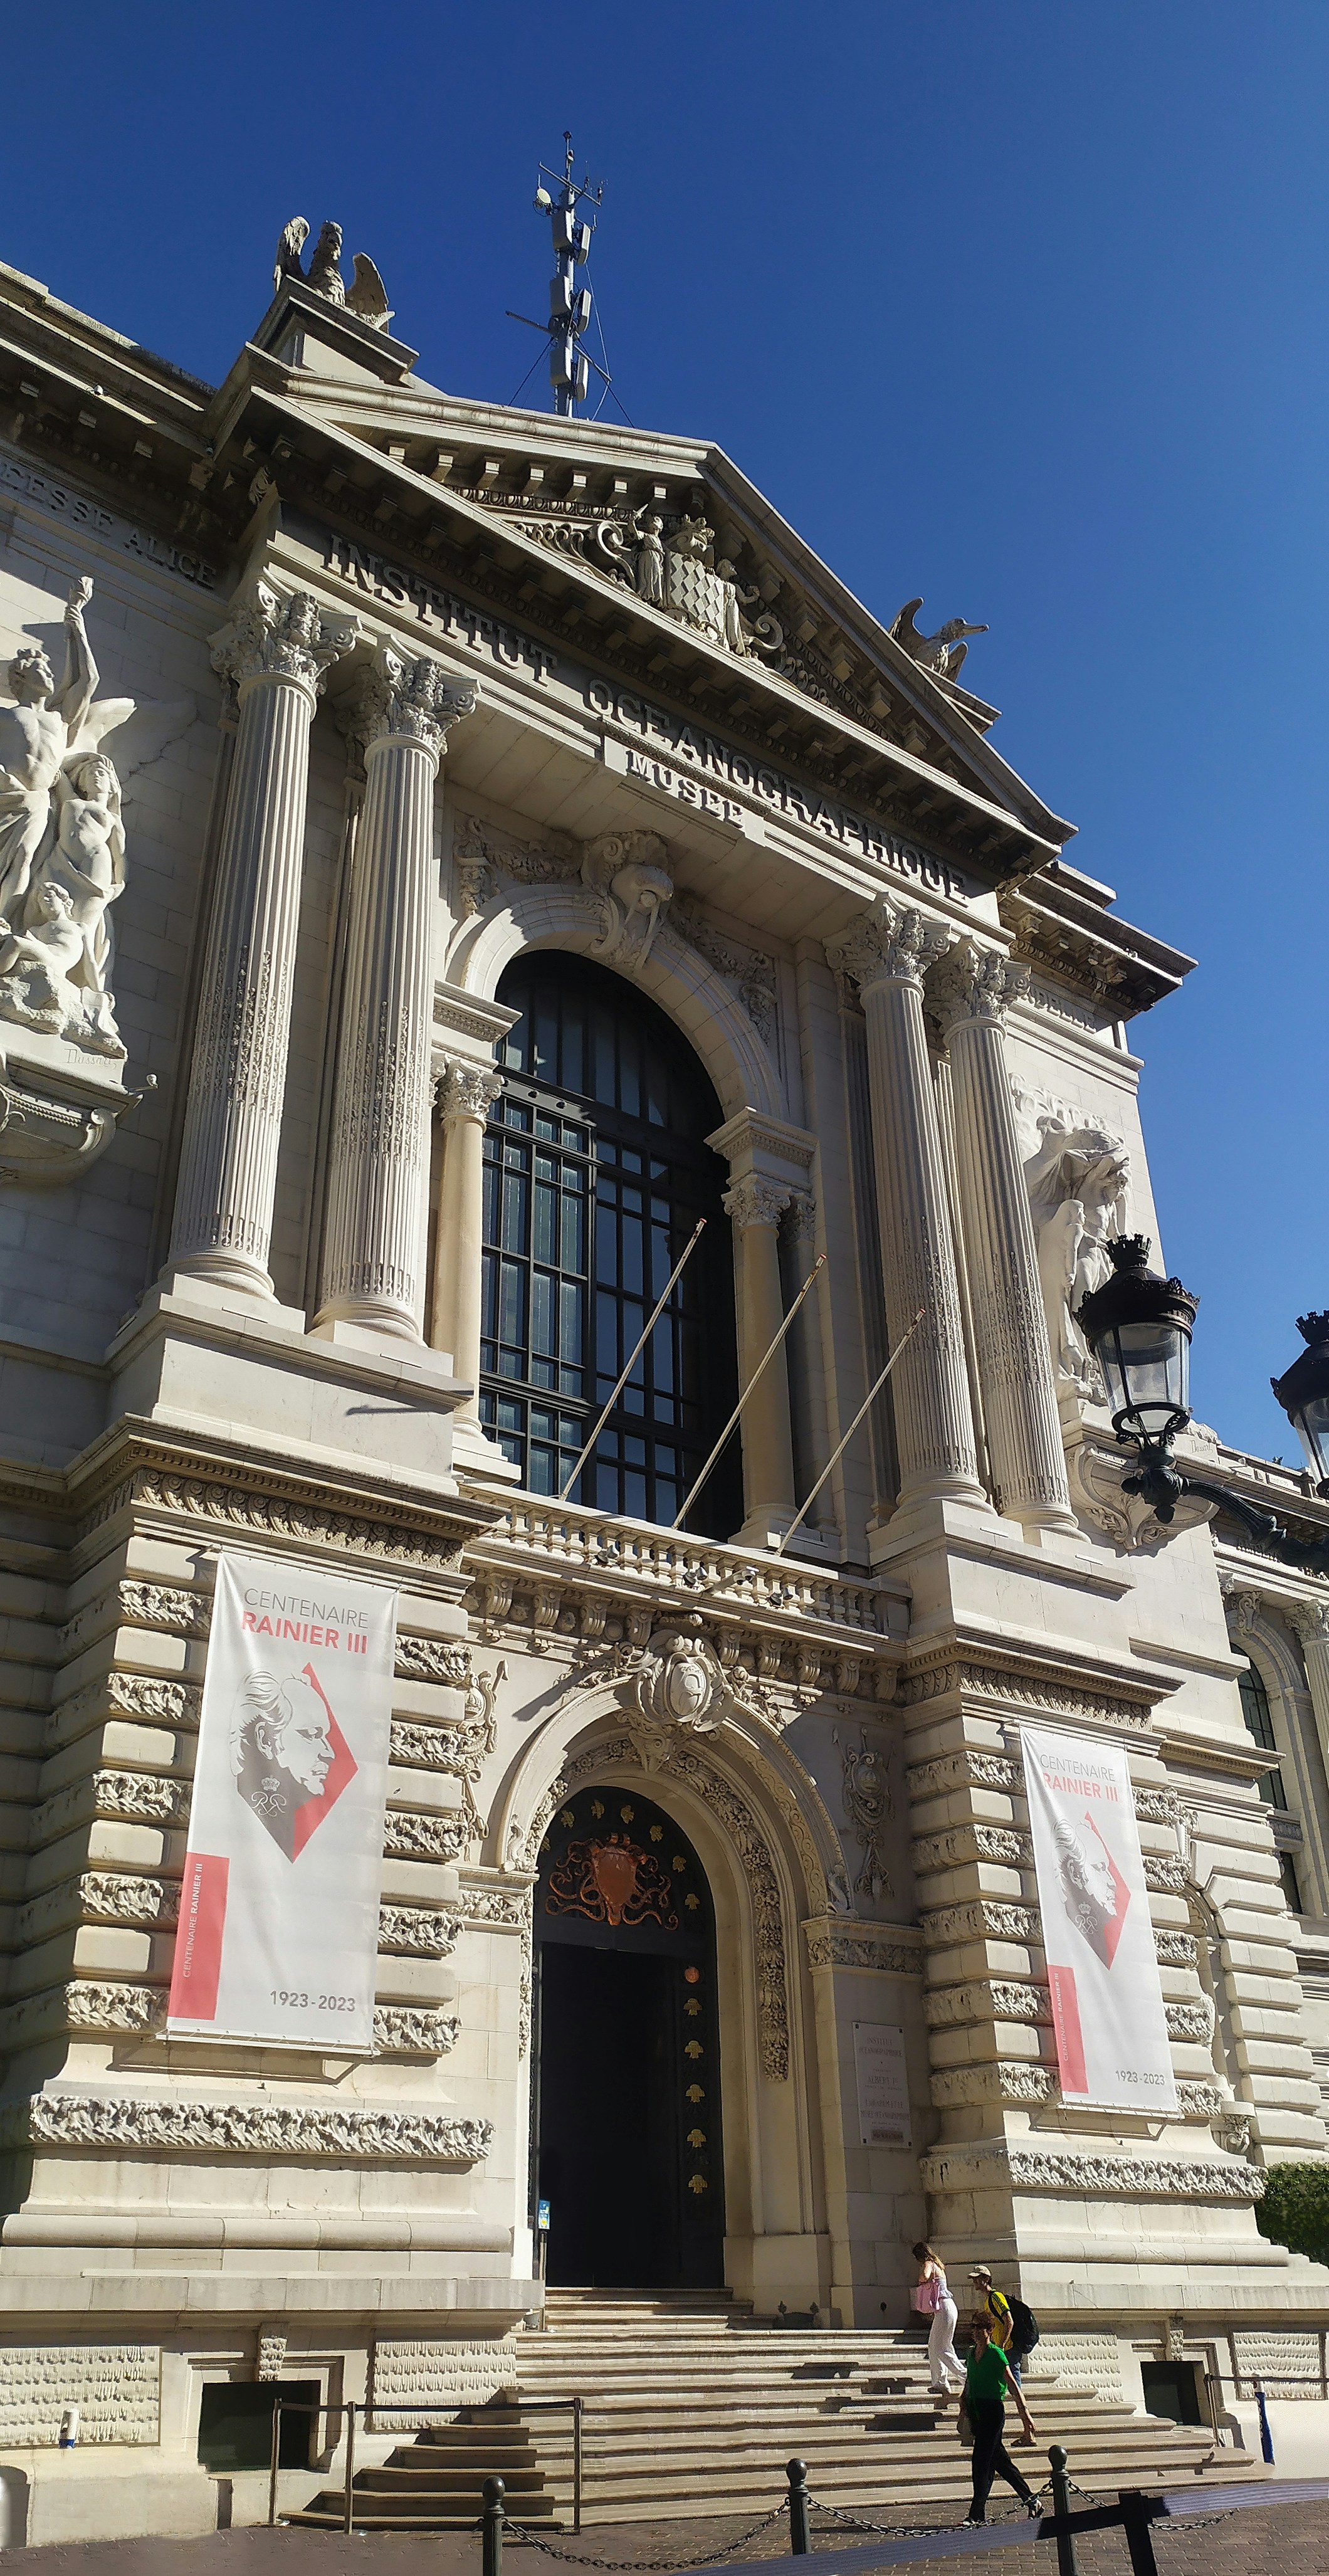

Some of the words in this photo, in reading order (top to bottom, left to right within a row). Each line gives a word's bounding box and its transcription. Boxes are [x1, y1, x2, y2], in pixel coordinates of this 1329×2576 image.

[123, 528, 216, 591] ALICE
[322, 534, 557, 687] INSTITUT
[587, 679, 970, 908] OCEANOGRAPHIQUE
[626, 749, 744, 828] MUSEE
[244, 1588, 369, 1629] CENTENAIRE
[242, 1611, 340, 1649] RAINIER
[347, 1632, 367, 1654] III
[1041, 1754, 1115, 1782] CENTENAIRE
[1043, 1772, 1101, 1799] RAINIER
[1106, 1785, 1118, 1802] III
[183, 1916, 197, 1977] CENTENAIRE
[191, 1873, 202, 1914] RAINIER
[270, 1990, 356, 2012] 1923-2023
[1058, 2014, 1069, 2061] CENTENAIRE
[1115, 2070, 1165, 2085] 1923-2023
